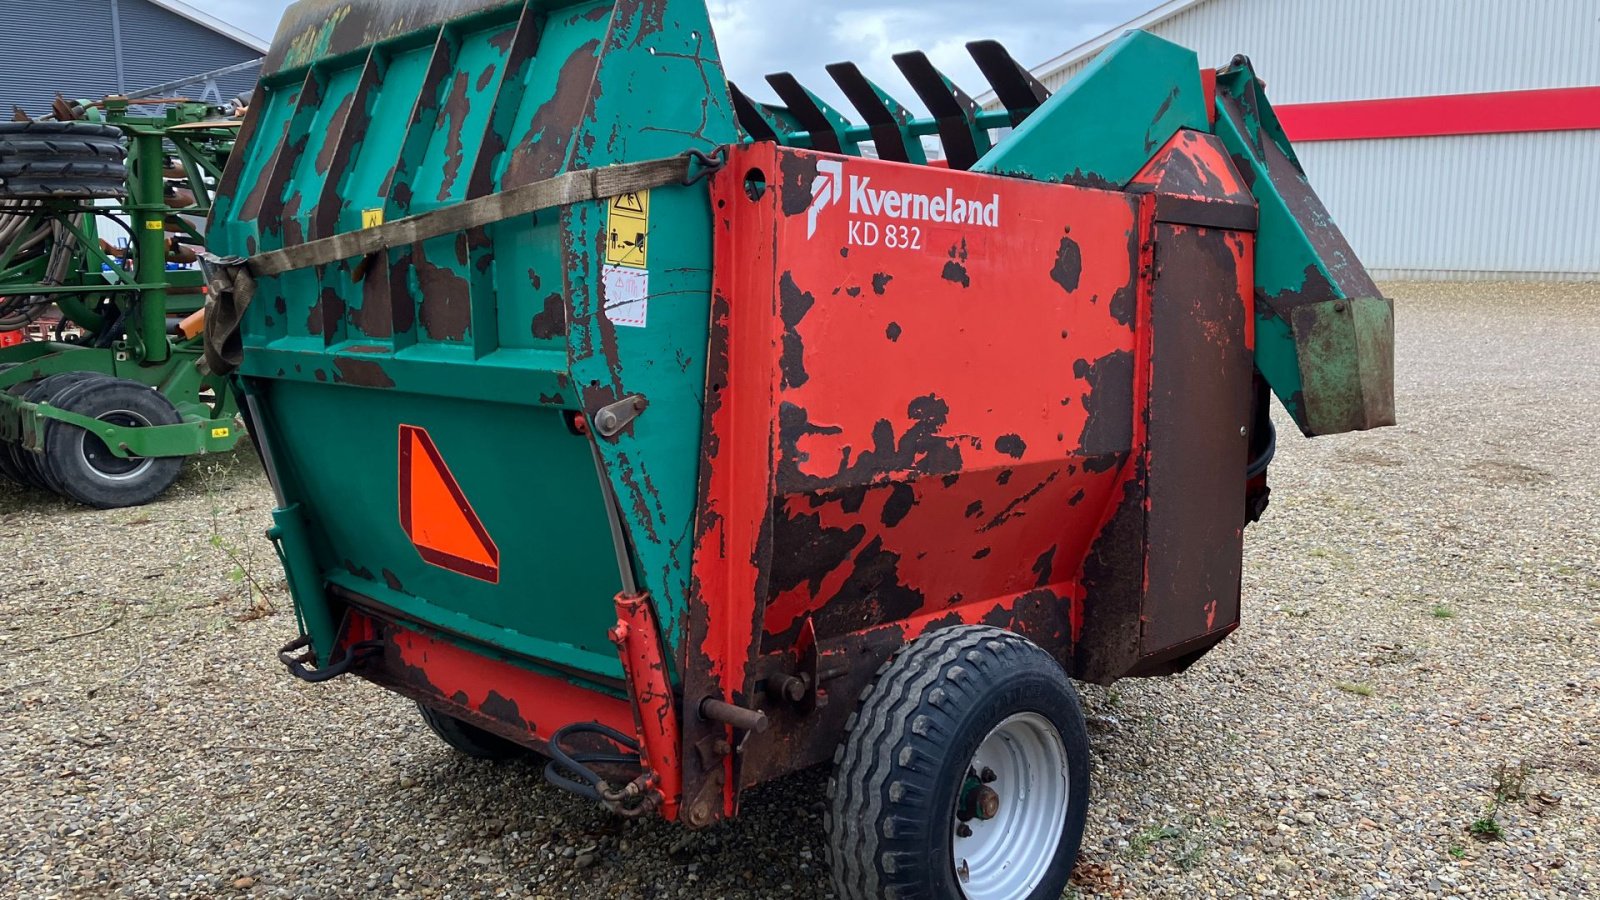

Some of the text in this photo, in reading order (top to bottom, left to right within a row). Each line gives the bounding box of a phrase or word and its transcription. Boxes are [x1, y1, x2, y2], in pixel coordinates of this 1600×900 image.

[848, 174, 1000, 228] Kverneland
[848, 220, 922, 250] KD 832
